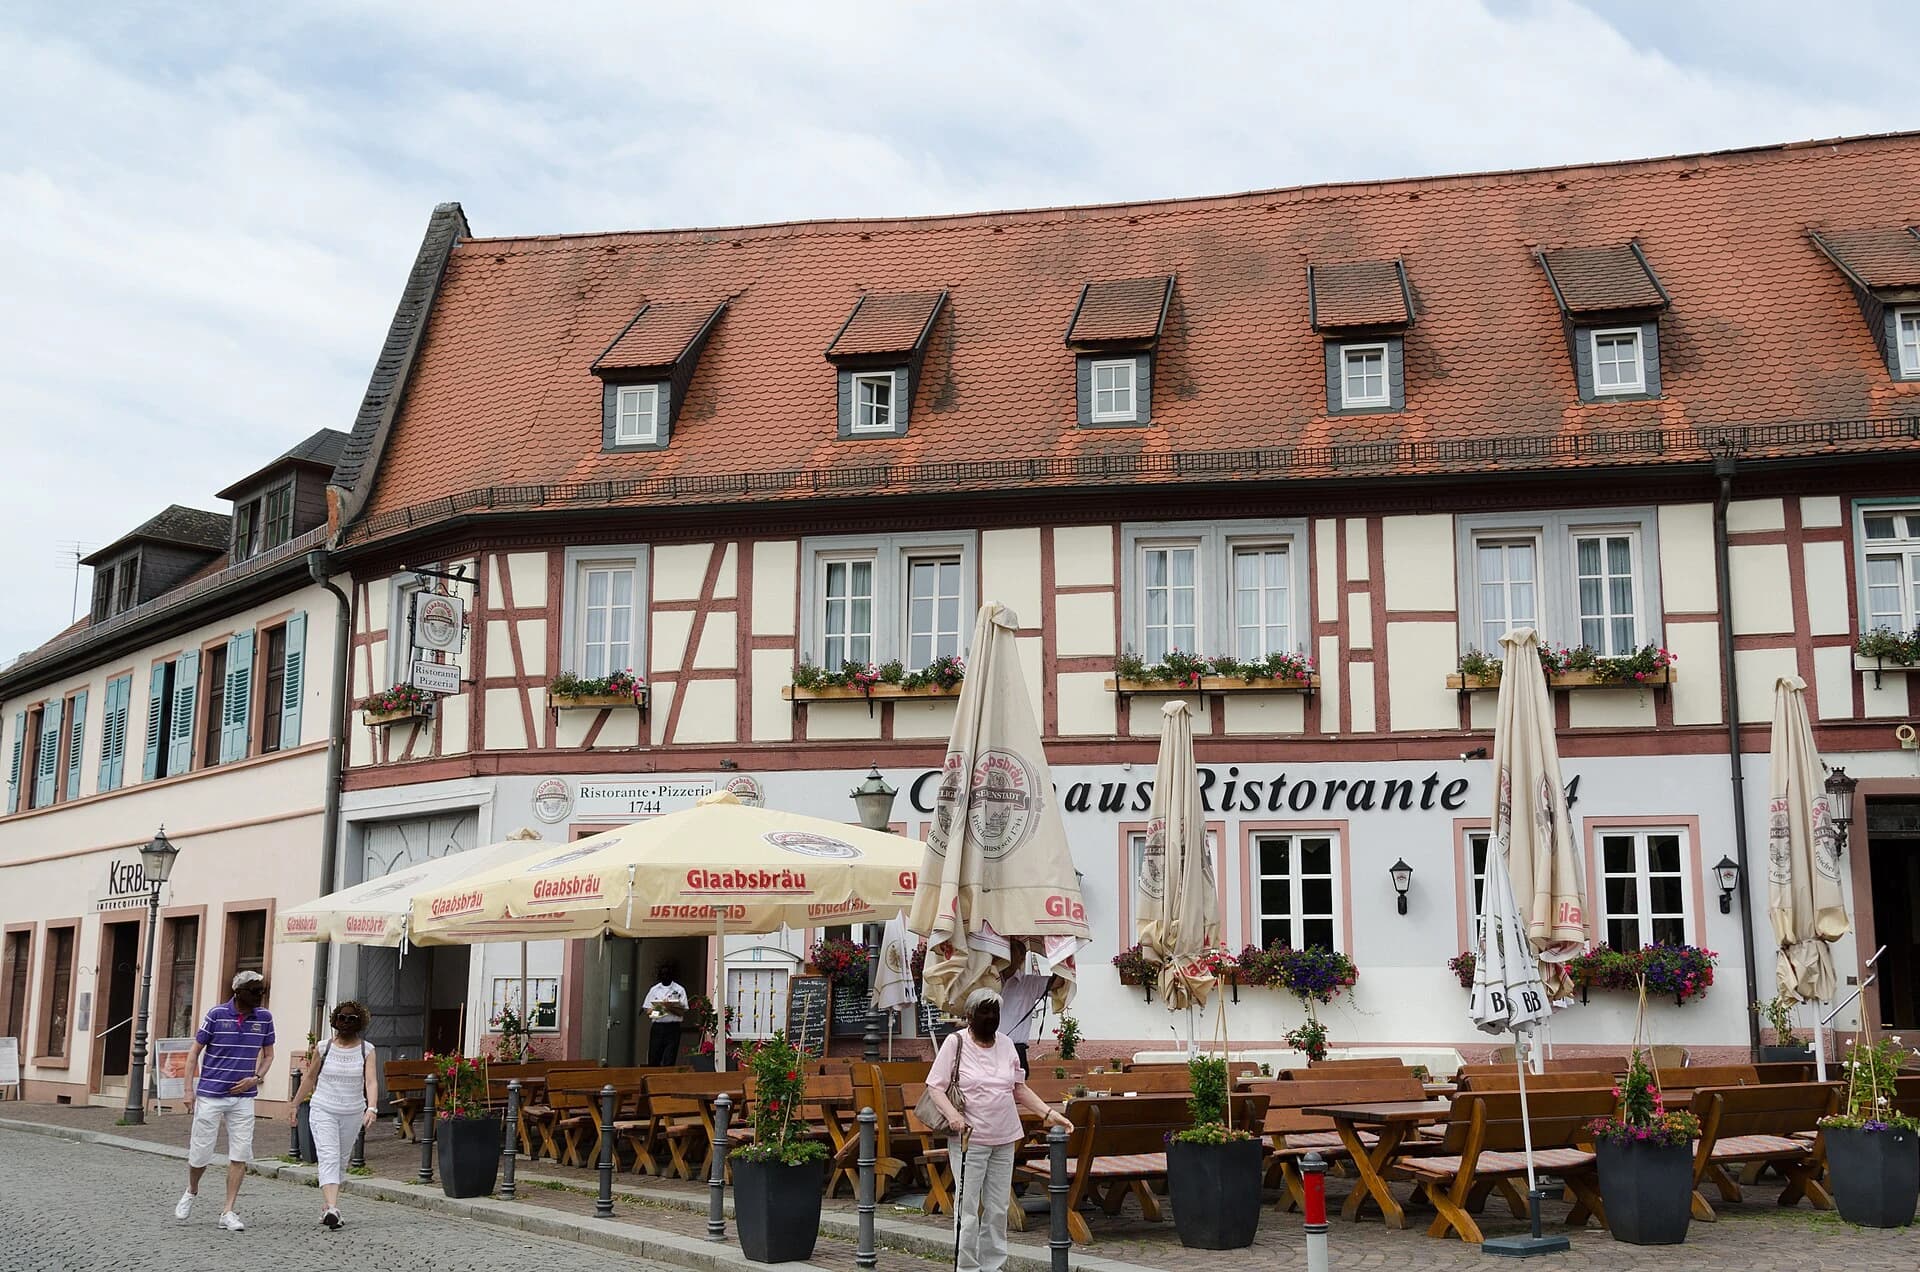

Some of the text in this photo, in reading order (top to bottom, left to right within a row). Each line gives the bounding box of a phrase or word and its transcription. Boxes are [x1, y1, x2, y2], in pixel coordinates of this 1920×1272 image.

[415, 665, 459, 679] Ristorante
[419, 676, 454, 688] Pizzeria
[580, 784, 713, 799] Ristorante Pizzeria
[628, 801, 662, 814] 1744
[533, 873, 601, 899] Glaabsbräu
[687, 869, 807, 889] Glaabsbräu
[431, 890, 484, 916] Glaabsbräu
